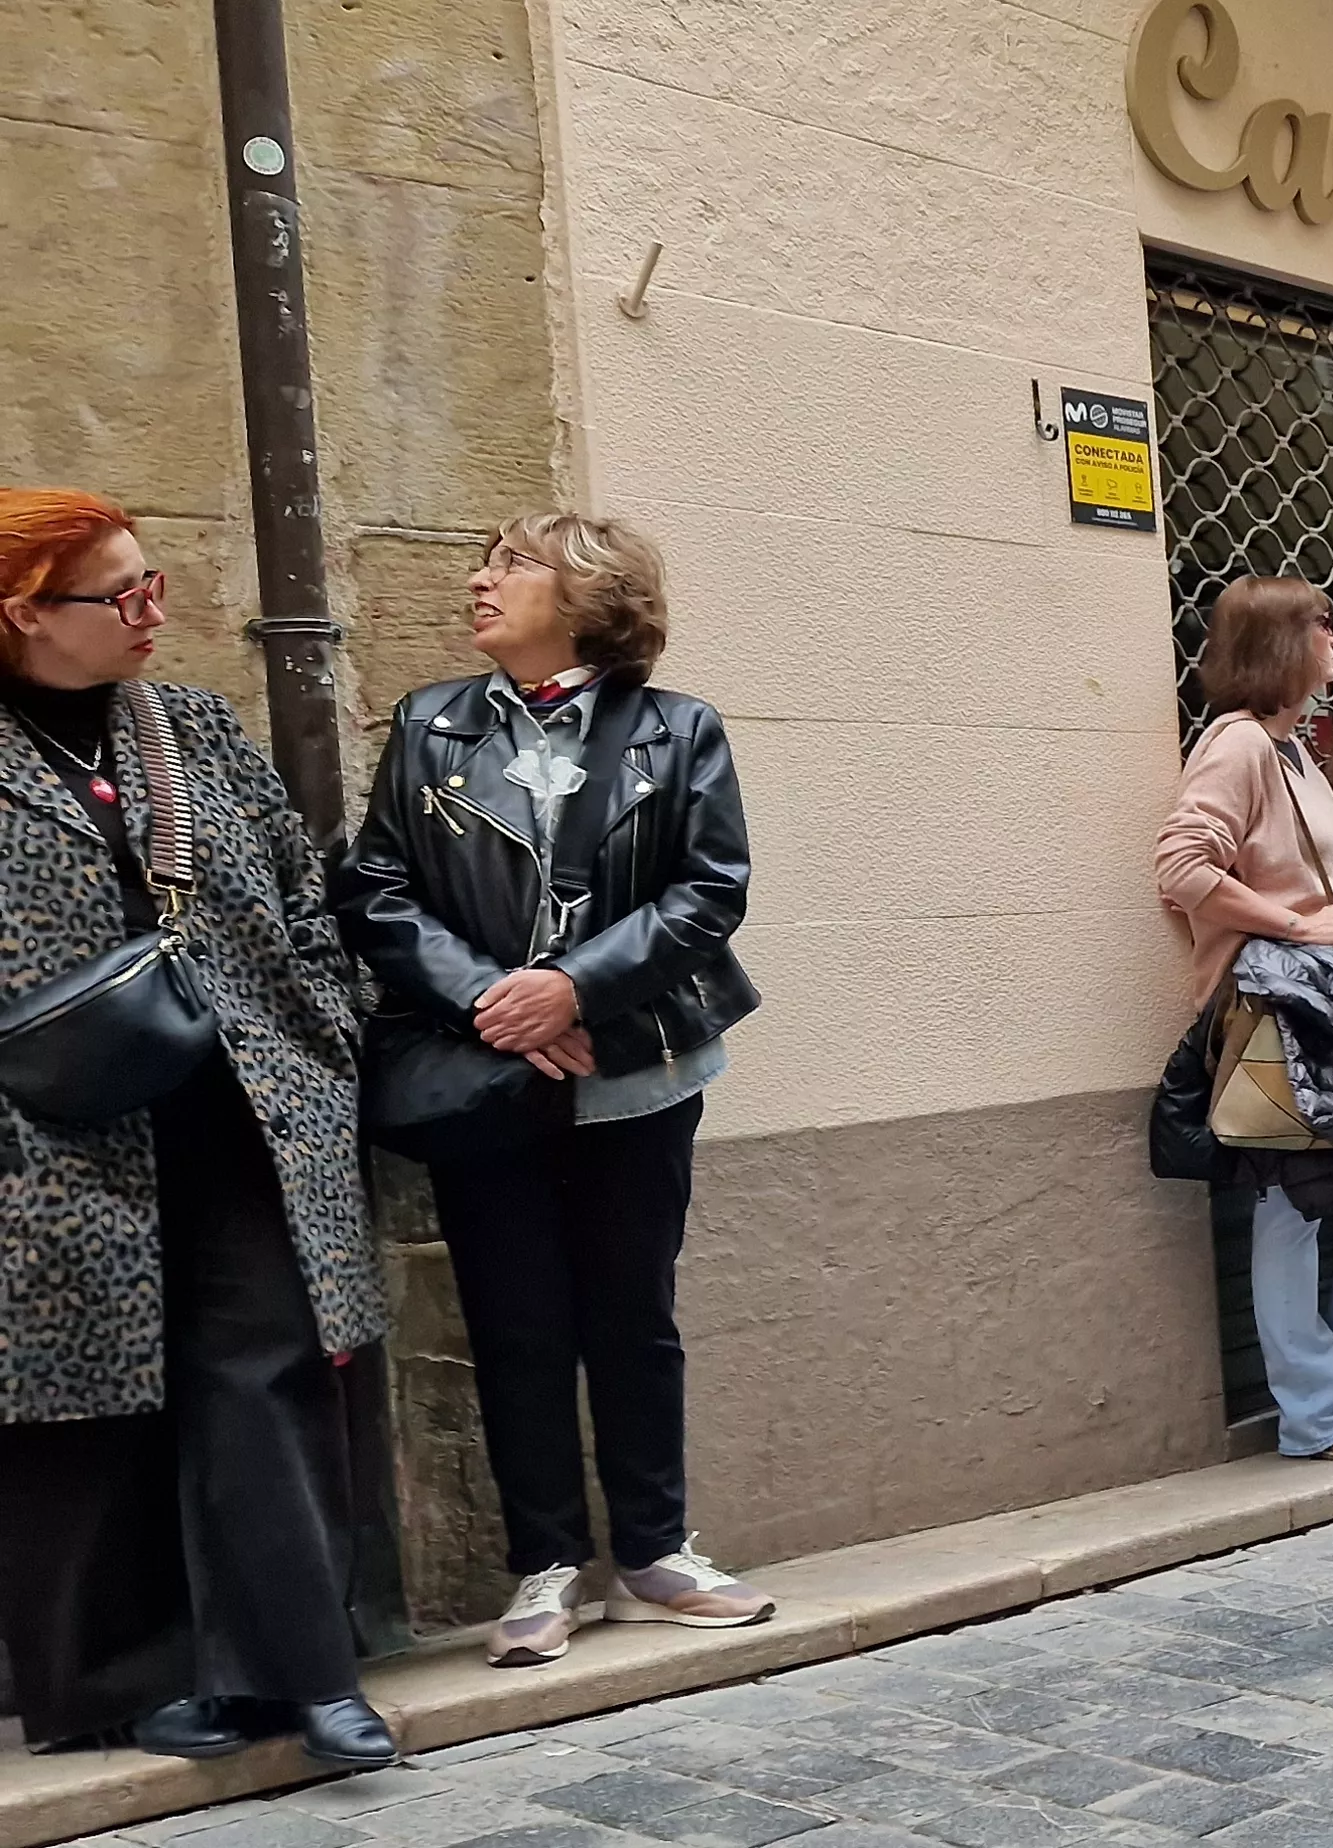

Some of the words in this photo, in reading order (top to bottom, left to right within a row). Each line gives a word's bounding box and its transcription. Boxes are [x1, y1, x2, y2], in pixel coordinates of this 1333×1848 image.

[1075, 444, 1144, 465] CONECTADA
[1075, 458, 1091, 466] CON
[1092, 460, 1113, 469] AVISO
